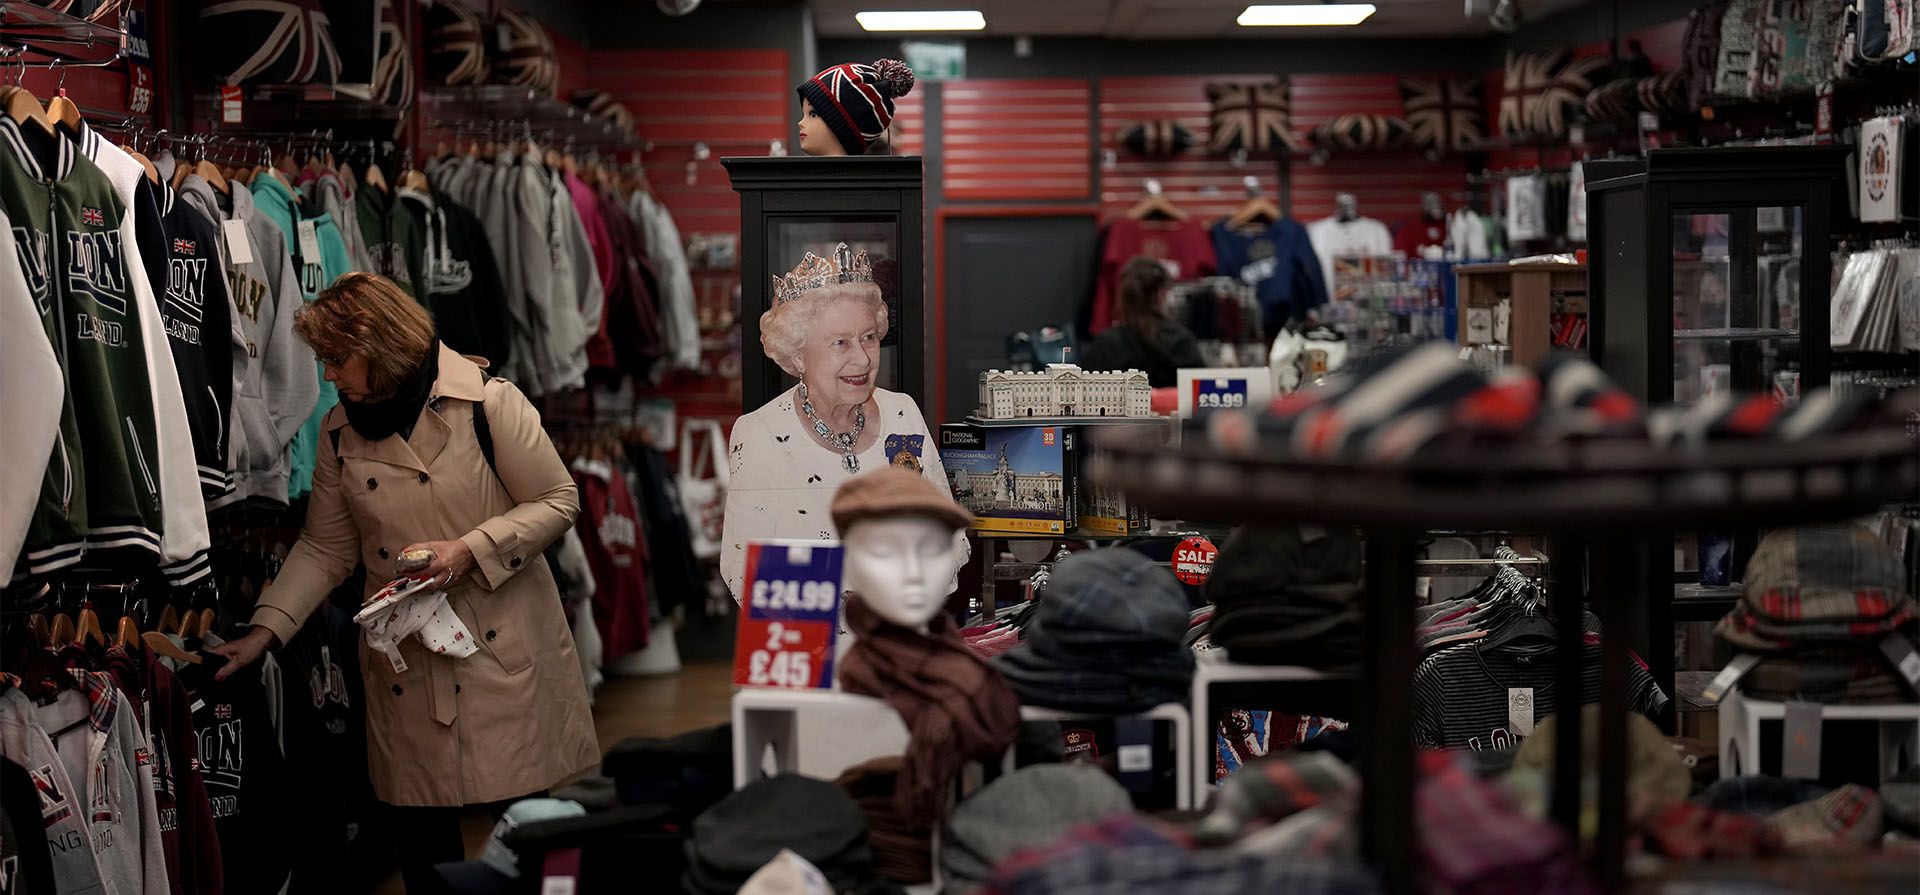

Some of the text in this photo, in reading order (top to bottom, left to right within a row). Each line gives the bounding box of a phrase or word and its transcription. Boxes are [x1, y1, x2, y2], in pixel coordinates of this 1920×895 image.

[163, 314, 199, 345] LAND
[1199, 392, 1244, 408] £9.99
[1043, 432, 1054, 441] 3D
[1010, 498, 1051, 510] London
[1177, 550, 1215, 563] SALE
[751, 579, 836, 612] £24.99
[766, 621, 784, 650] 2
[748, 649, 812, 686] £45
